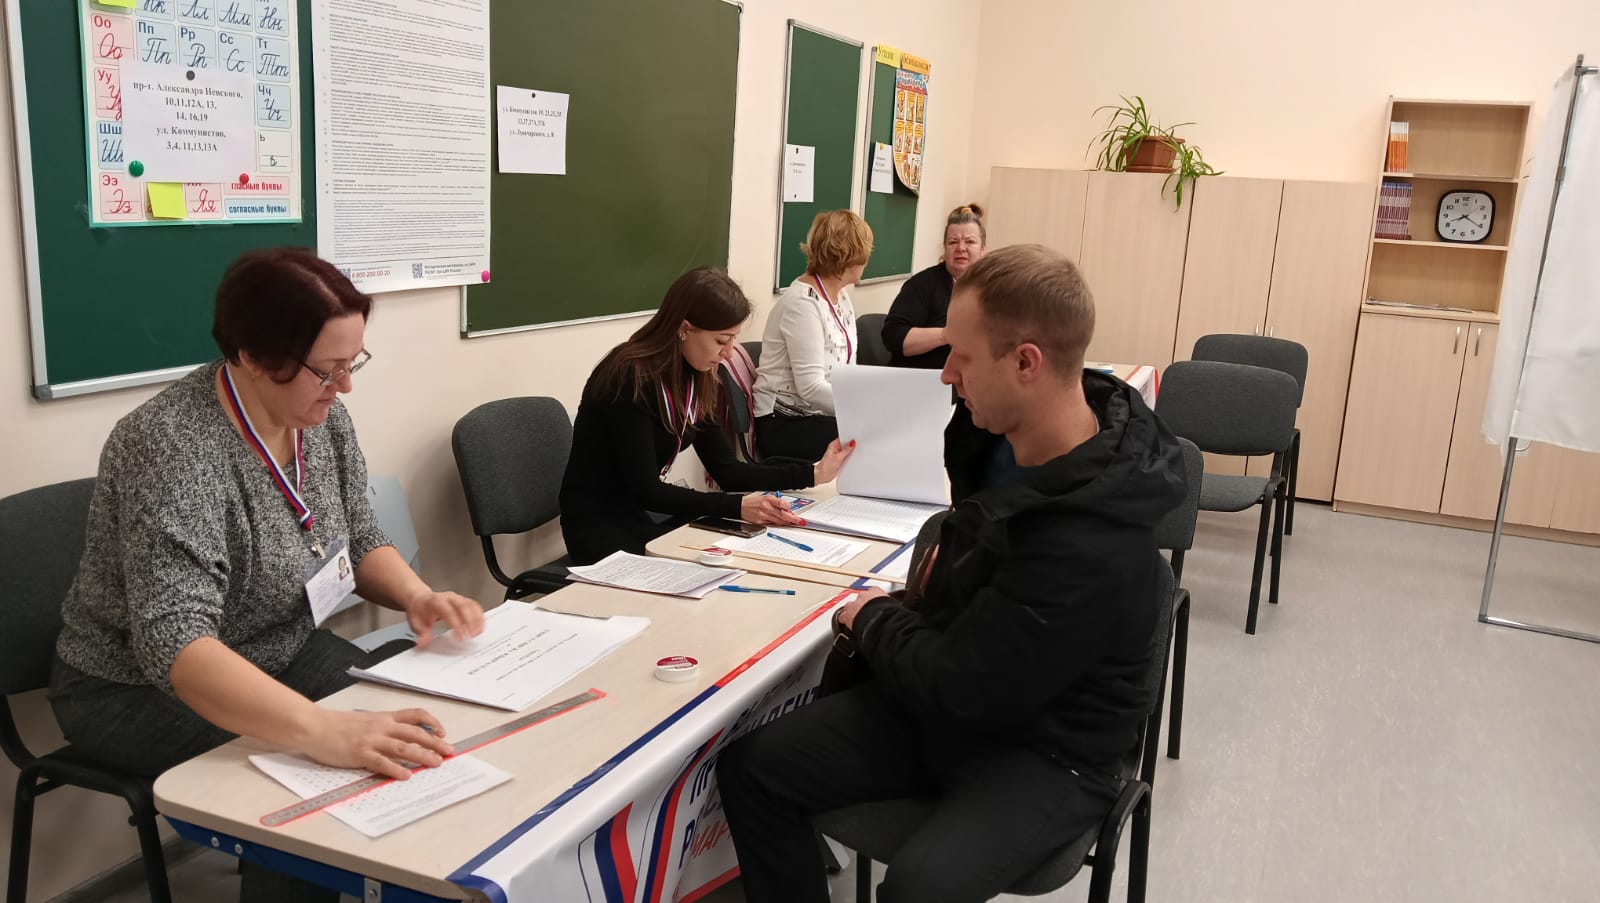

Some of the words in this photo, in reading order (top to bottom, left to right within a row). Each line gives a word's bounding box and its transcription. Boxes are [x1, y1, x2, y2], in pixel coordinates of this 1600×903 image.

[138, 21, 154, 34] Пп
[181, 28, 196, 42] Рр
[133, 82, 154, 92] пр-т.
[157, 84, 204, 96] Александра
[205, 88, 243, 99] Невского,
[171, 126, 227, 138] Коммунистов,
[261, 182, 283, 192] буквы
[228, 205, 265, 214] согласные
[266, 204, 287, 215] буквы
